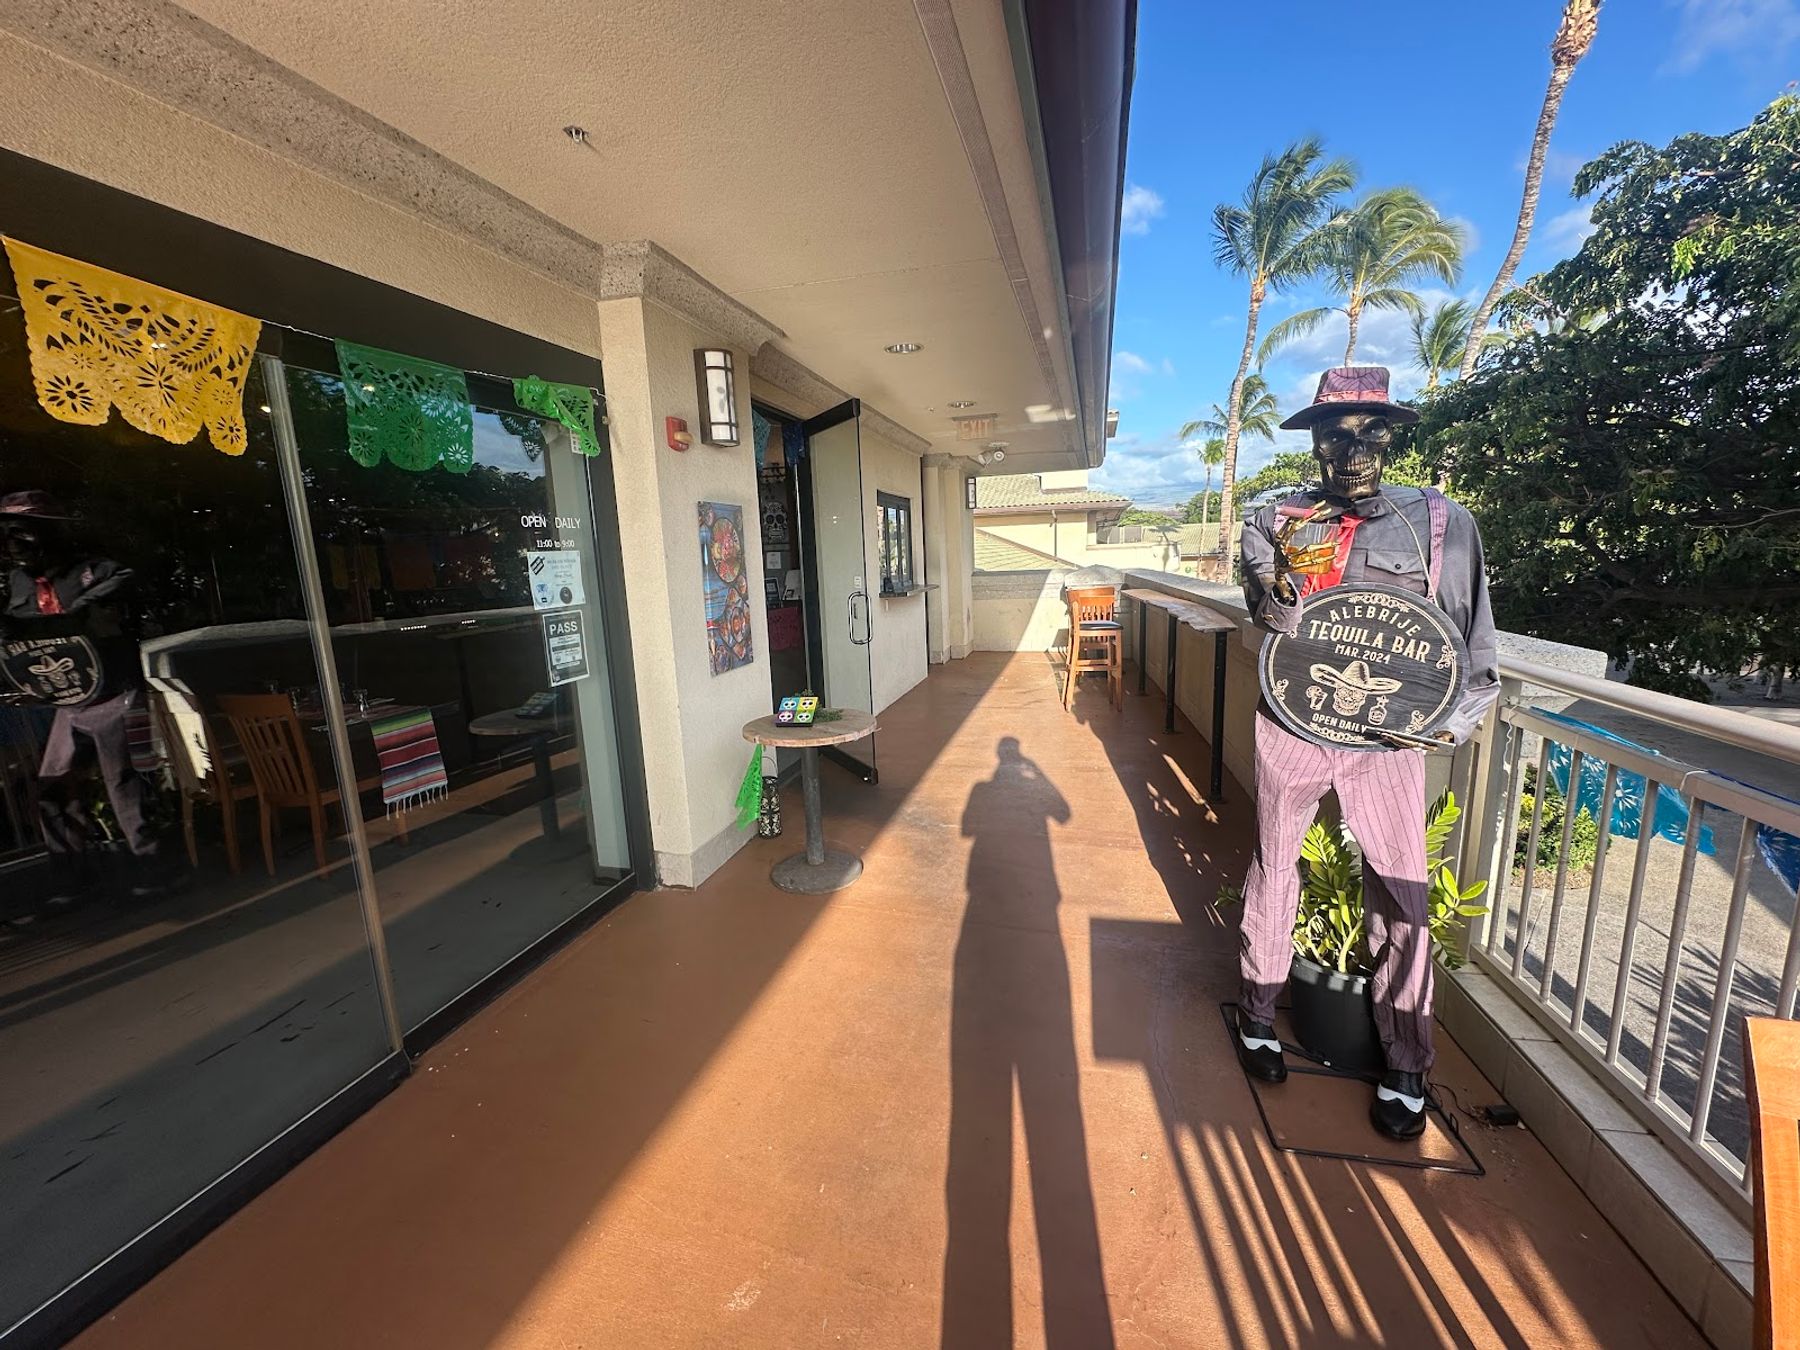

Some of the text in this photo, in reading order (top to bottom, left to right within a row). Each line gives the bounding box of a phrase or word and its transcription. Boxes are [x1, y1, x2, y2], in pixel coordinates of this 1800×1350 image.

[960, 419, 991, 438] EXIT
[520, 515, 581, 529] OPEN DAILY
[536, 539, 553, 548] 11:00
[554, 540, 561, 548] to
[549, 620, 578, 636] PASS
[1329, 605, 1421, 637] ALEBRIJE
[1308, 619, 1431, 664] TEQUILA BAR
[1312, 712, 1367, 734] OPEN DAILY
